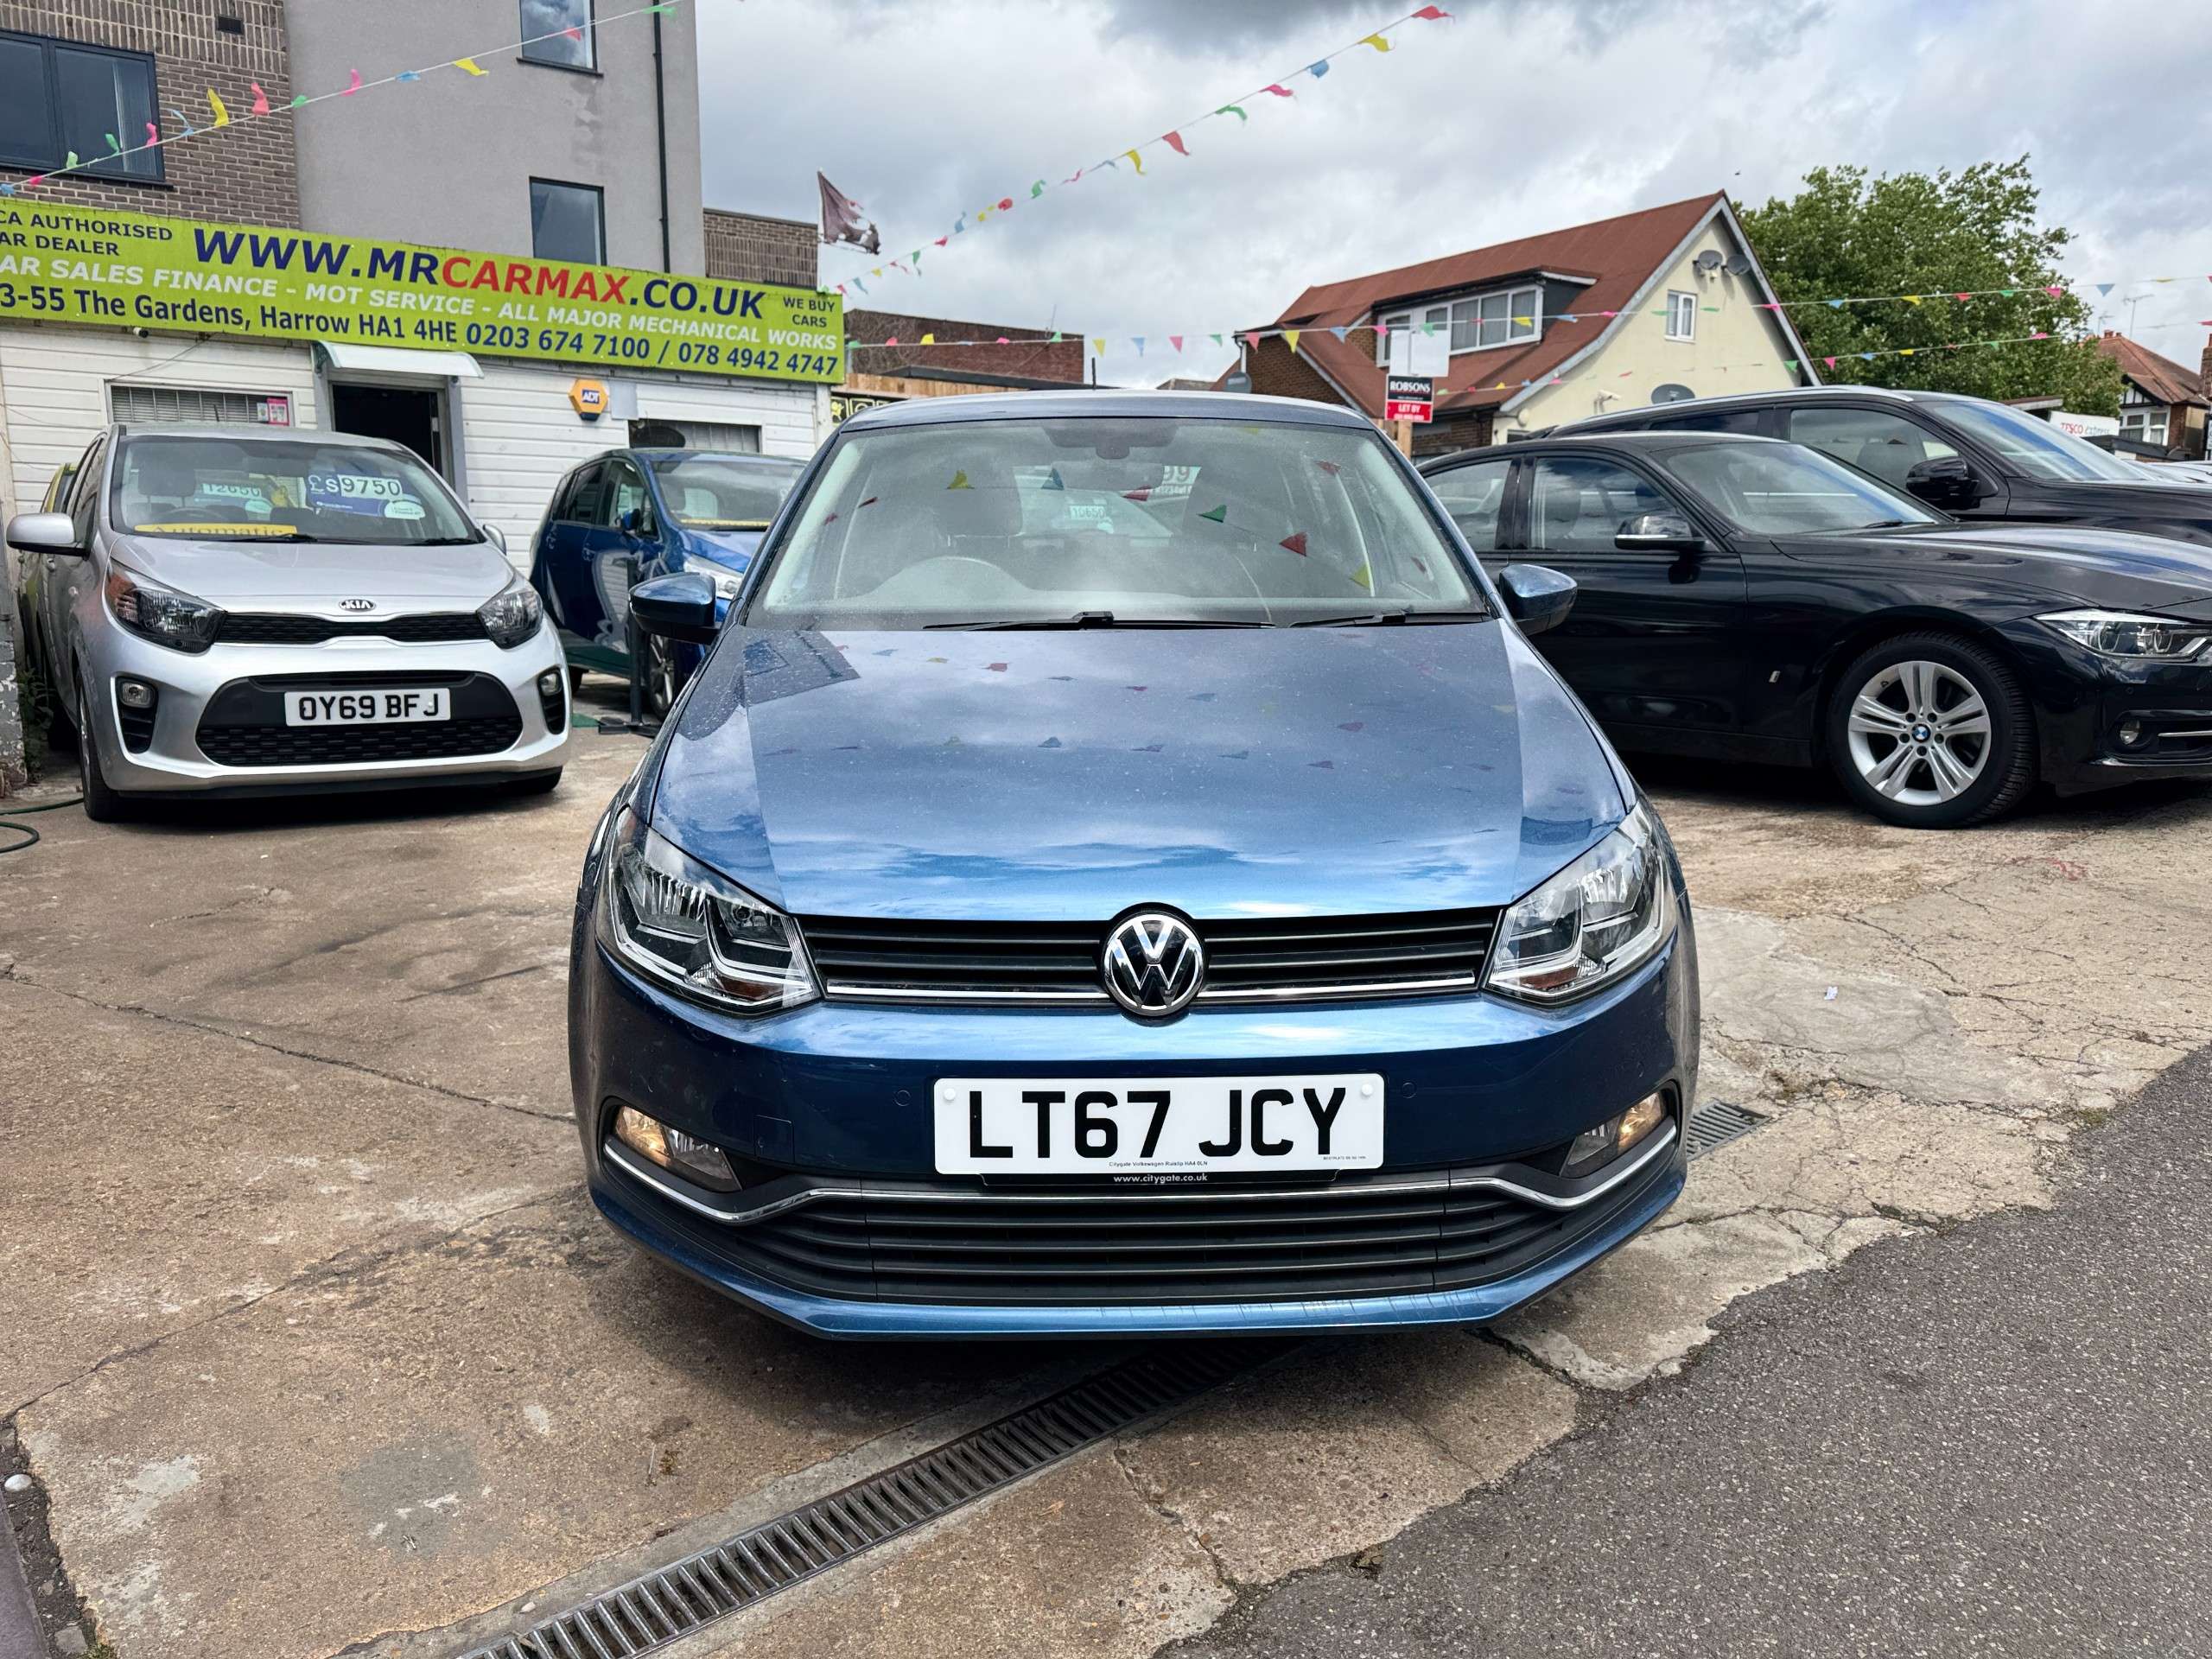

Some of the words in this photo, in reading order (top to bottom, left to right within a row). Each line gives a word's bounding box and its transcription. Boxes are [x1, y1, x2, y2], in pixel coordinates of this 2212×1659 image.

[31, 213, 173, 241] AUTHORISED
[35, 234, 120, 256] DEALER
[194, 228, 766, 320] WWW.MRCARMAX.CO.UK
[50, 258, 144, 286] SALES
[153, 269, 277, 297] FINANCE
[305, 284, 363, 305] MOT
[369, 289, 474, 316] SERVICE
[498, 302, 539, 322] ALL
[547, 307, 621, 330] MAJOR
[629, 316, 761, 344] MECHANICAL
[767, 329, 837, 351] WORKS
[783, 296, 804, 309] WE
[808, 299, 836, 313] BUY
[792, 314, 827, 328] CARS
[73, 289, 126, 316] The
[135, 294, 251, 331] Gardens,
[260, 305, 349, 334] Harrow
[359, 314, 404, 340] HA1
[414, 318, 457, 344] 4HE
[466, 322, 530, 350] 0203
[538, 330, 583, 353] 674
[593, 334, 650, 359] 7100
[678, 342, 719, 365] 078
[727, 347, 779, 371] 4942
[786, 353, 838, 377] 4747
[1389, 380, 1431, 393] ROBSONS
[582, 390, 600, 404] ADT
[1398, 404, 1411, 413] LET
[1411, 404, 1421, 413] BY
[2060, 422, 2083, 435] TESCO
[345, 599, 372, 609] KIA
[298, 695, 376, 721] OY69
[385, 693, 439, 718] BFJ
[969, 1090, 1172, 1159] LT67
[1198, 1087, 1347, 1158] JCY
[1113, 1173, 1208, 1184] www.citygate.co.uk
